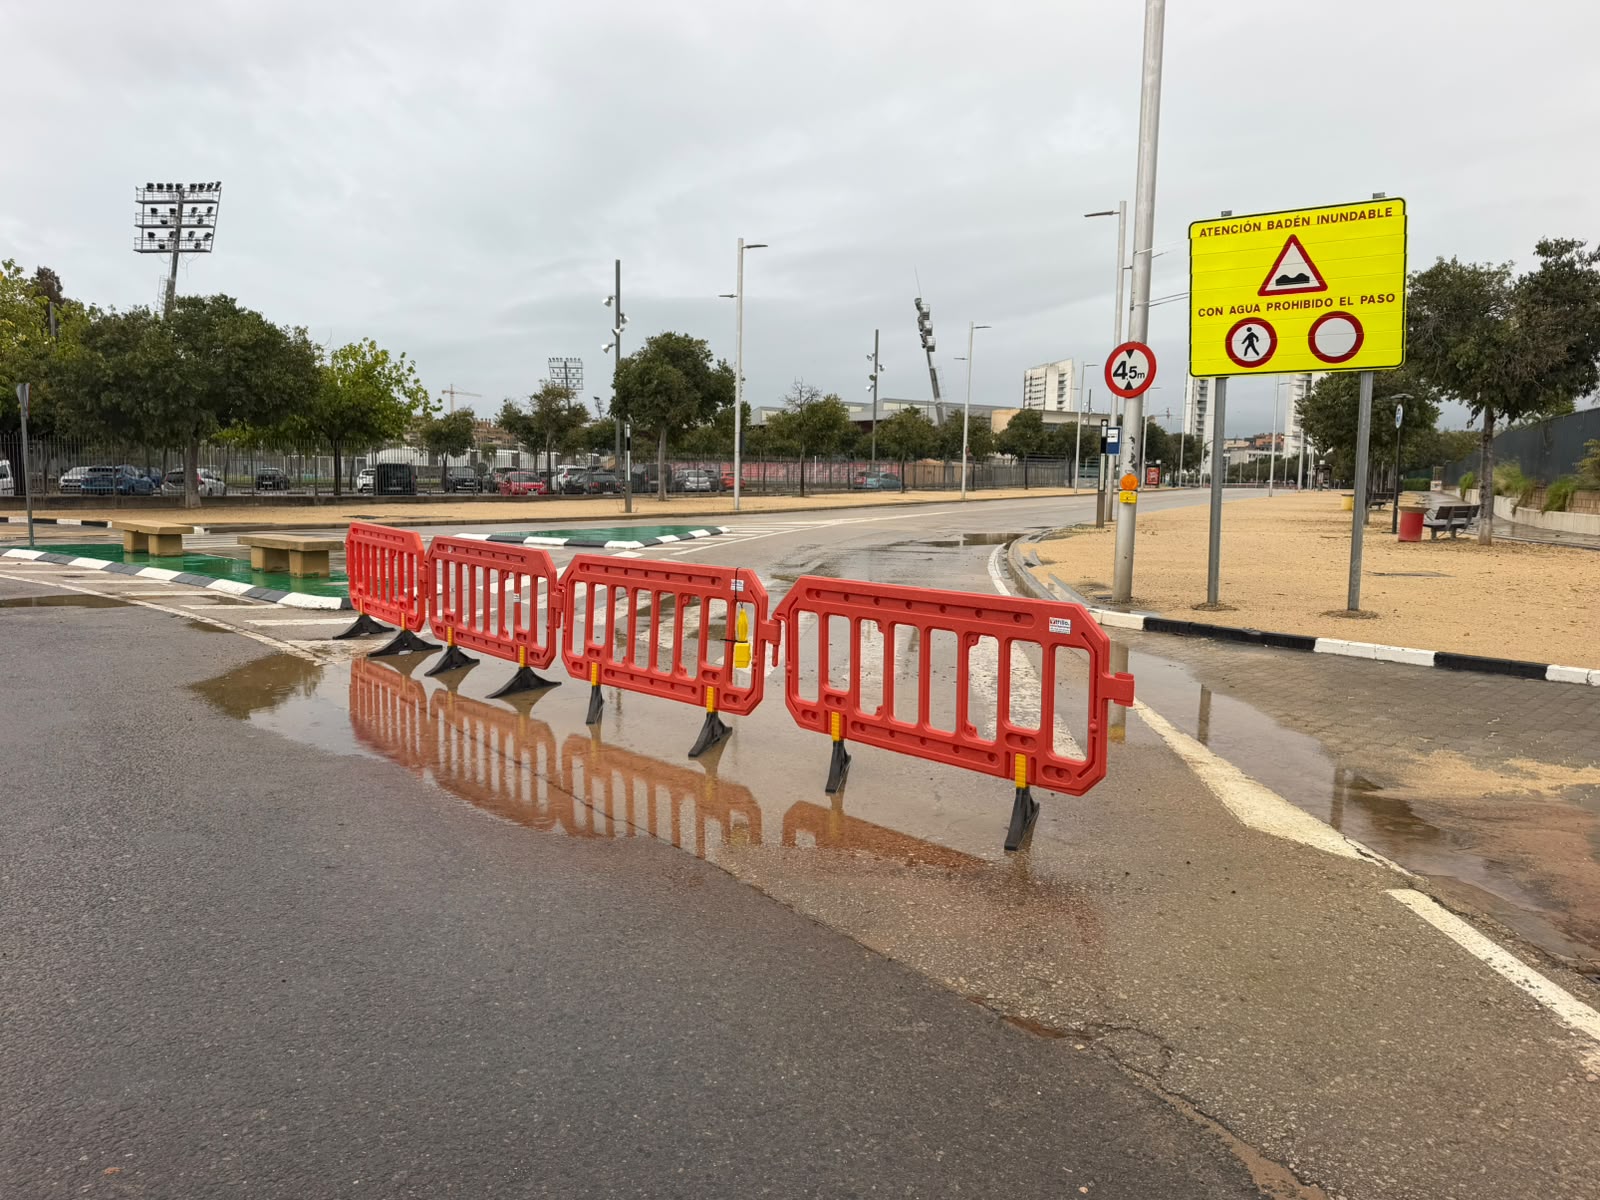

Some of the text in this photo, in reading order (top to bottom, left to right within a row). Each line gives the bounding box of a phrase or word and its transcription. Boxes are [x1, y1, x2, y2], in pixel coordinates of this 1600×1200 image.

[1199, 207, 1393, 238] ATENCIÓN BADÉN INUNDABLE
[1198, 293, 1396, 317] CON AGUA PROHIBIDO EL PASO
